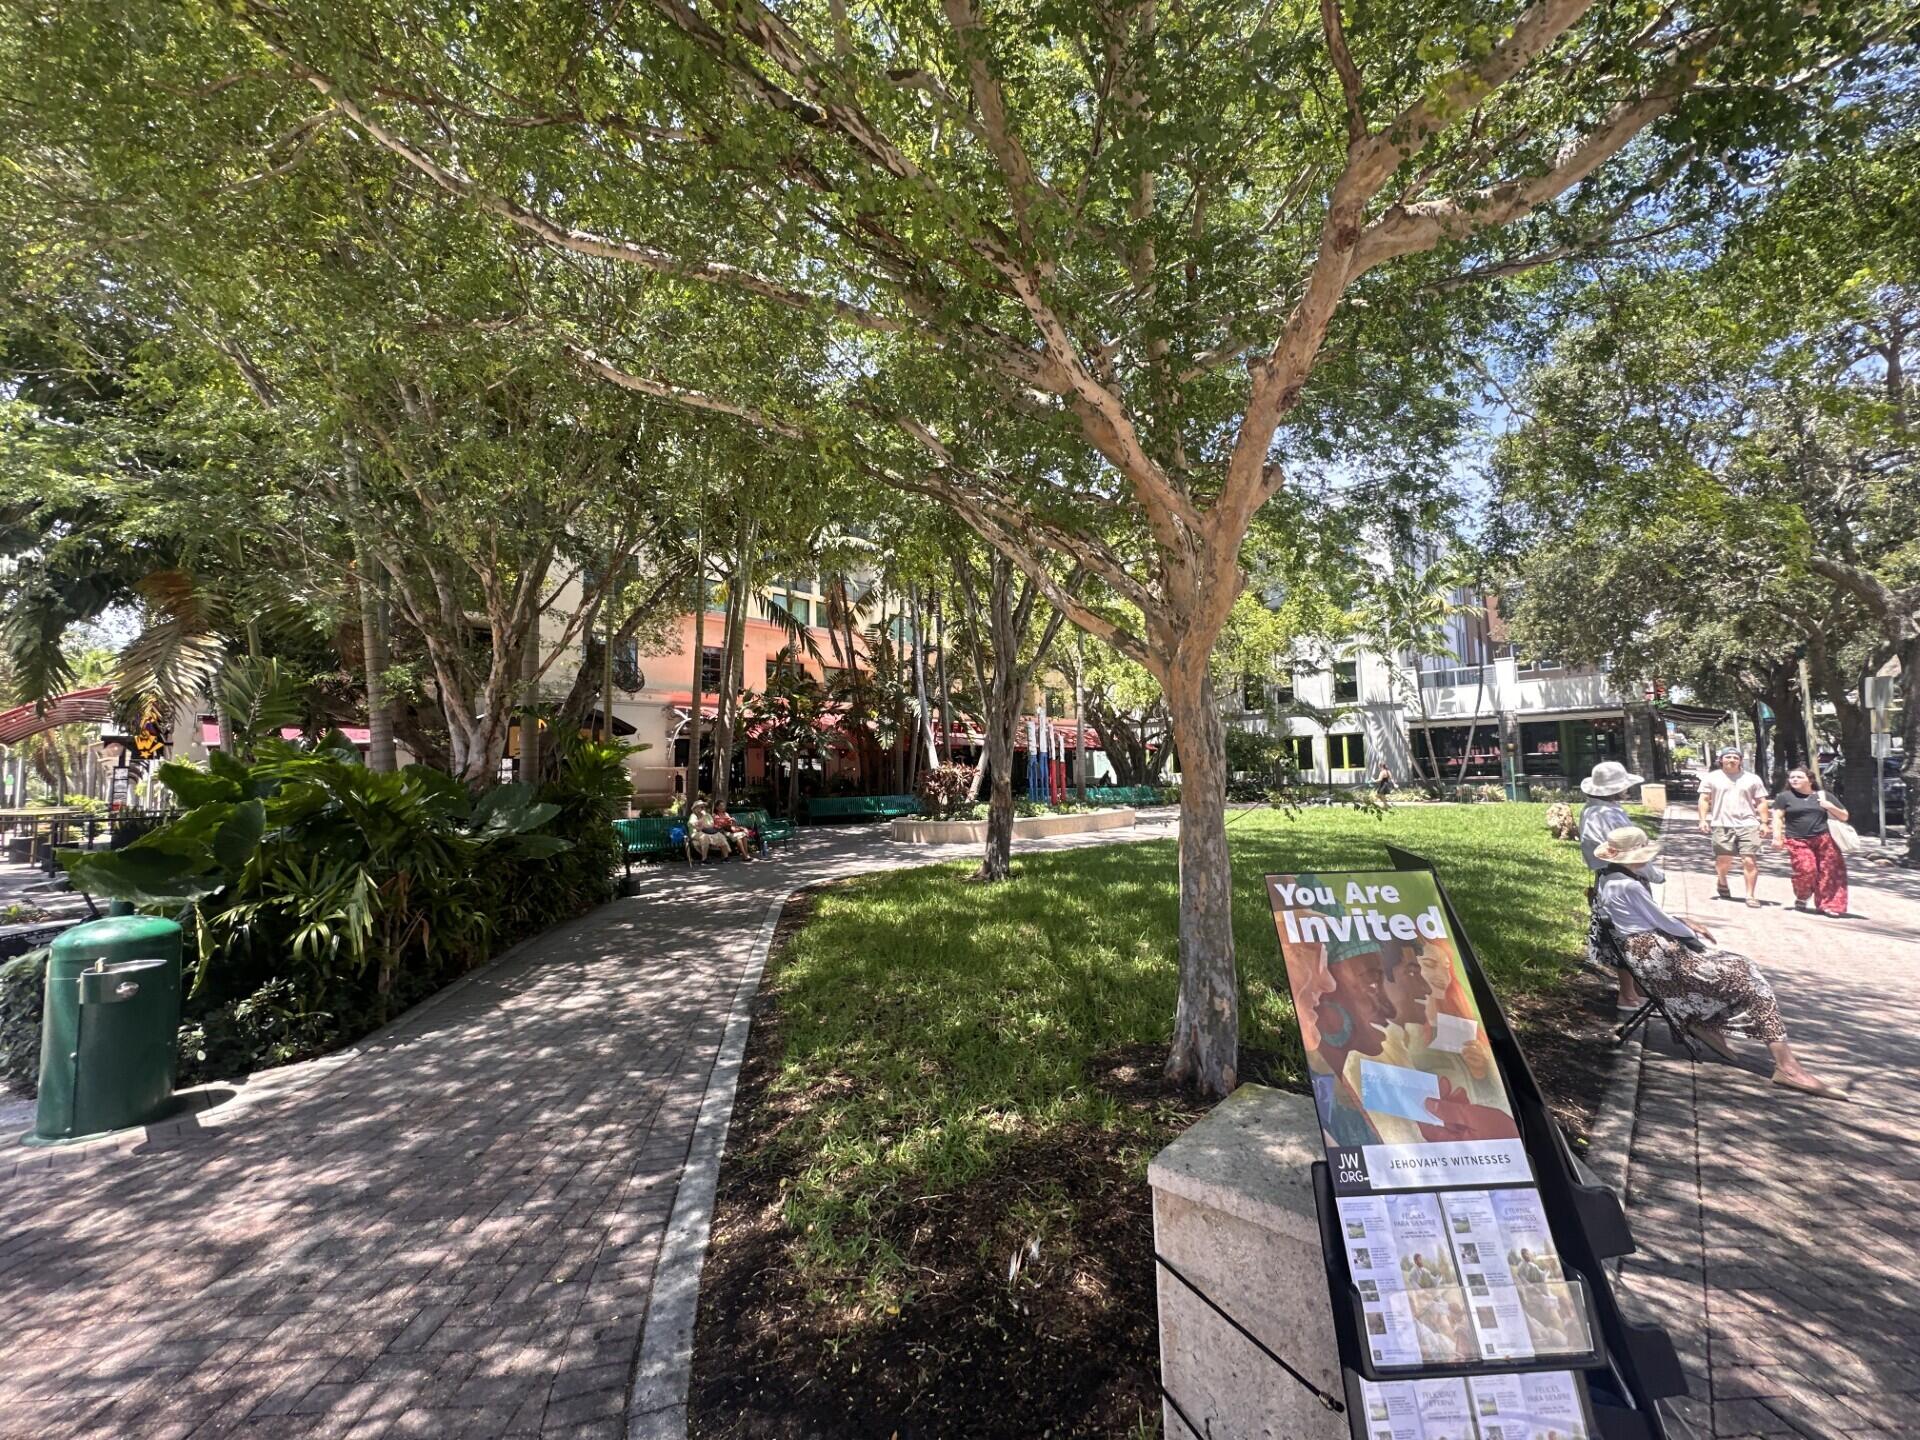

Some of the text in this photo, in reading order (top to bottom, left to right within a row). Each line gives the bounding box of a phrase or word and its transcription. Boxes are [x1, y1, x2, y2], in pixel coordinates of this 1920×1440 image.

[1274, 881, 1400, 906] You Are
[1282, 905, 1448, 943] Invited
[1338, 1152, 1359, 1170] JW
[1389, 1154, 1511, 1170] JEHOVAH'S WITNESSES
